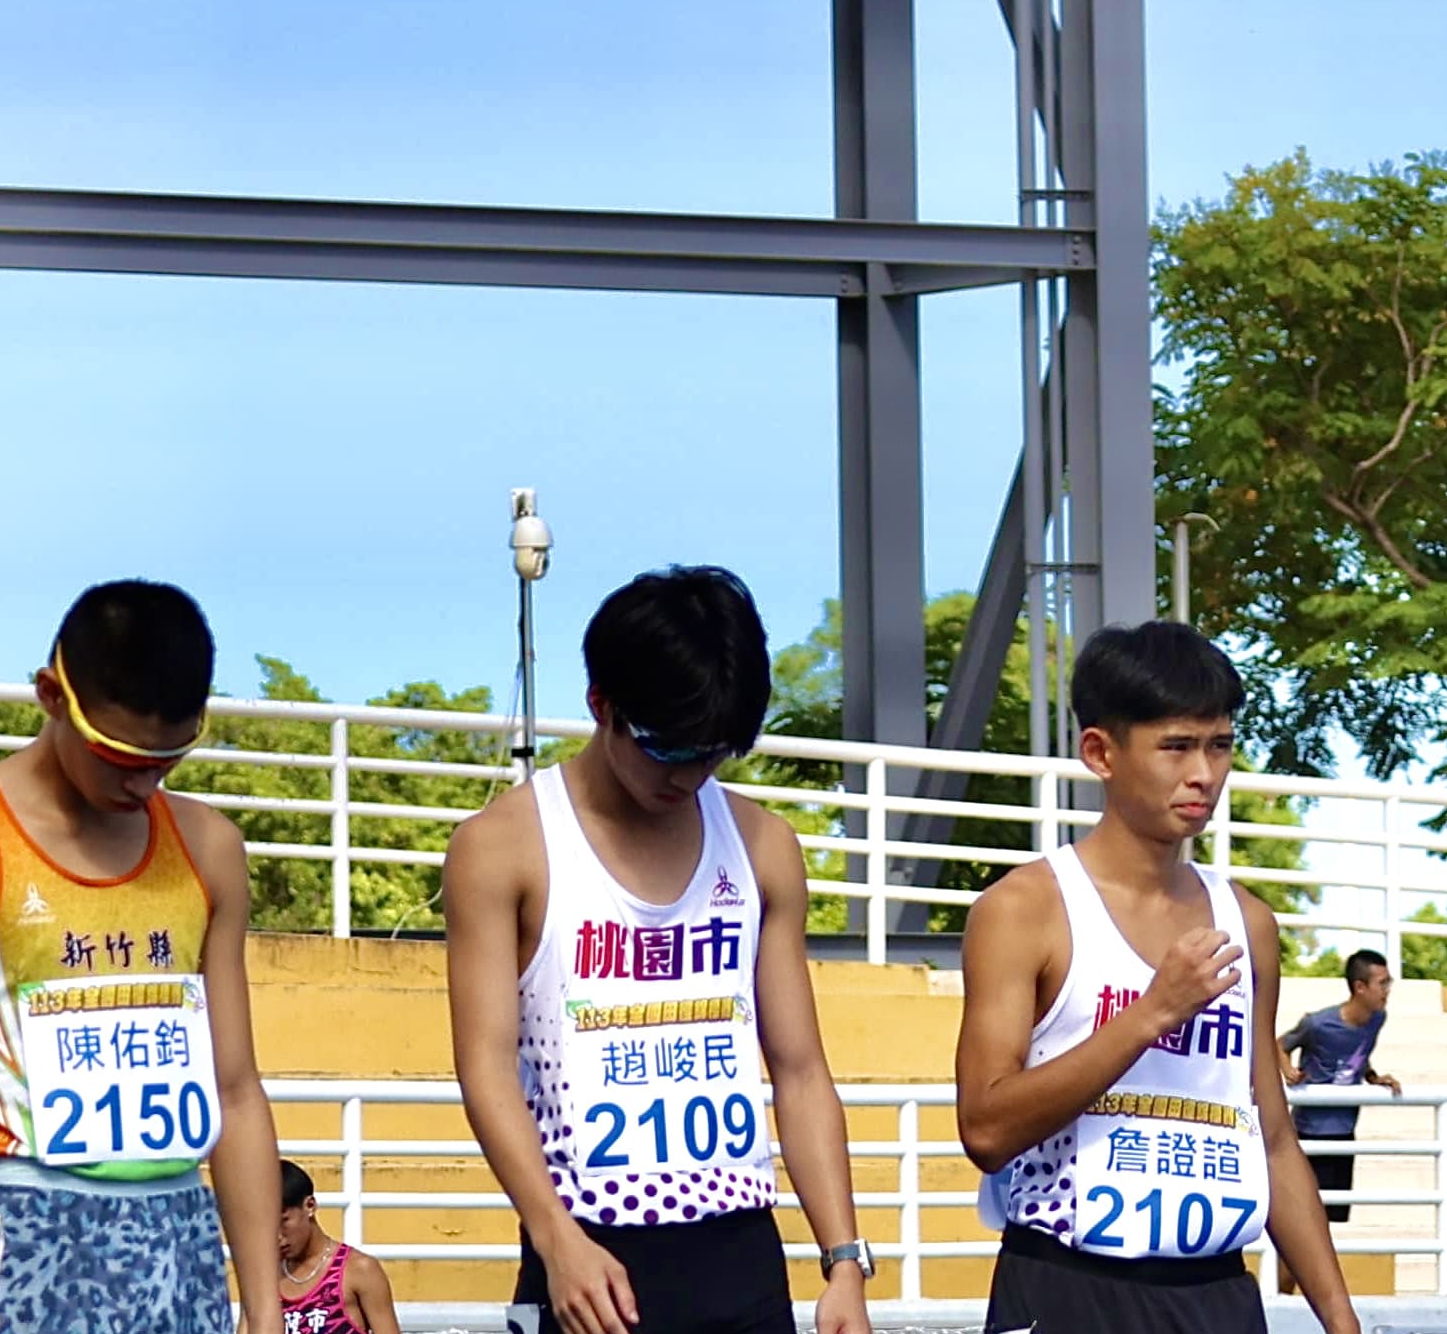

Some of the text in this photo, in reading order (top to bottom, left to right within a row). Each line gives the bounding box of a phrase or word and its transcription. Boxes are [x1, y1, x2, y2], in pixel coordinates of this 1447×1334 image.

[61, 929, 173, 970] 新竹縣
[575, 917, 742, 981] 桃園市
[56, 1019, 190, 1073] 陳佑鈞
[601, 1034, 737, 1086] 趙峻民
[42, 1081, 211, 1155] 2150
[585, 1093, 756, 1168] 2109
[1106, 1127, 1242, 1183] 詹證諠
[1083, 1185, 1257, 1254] 2107
